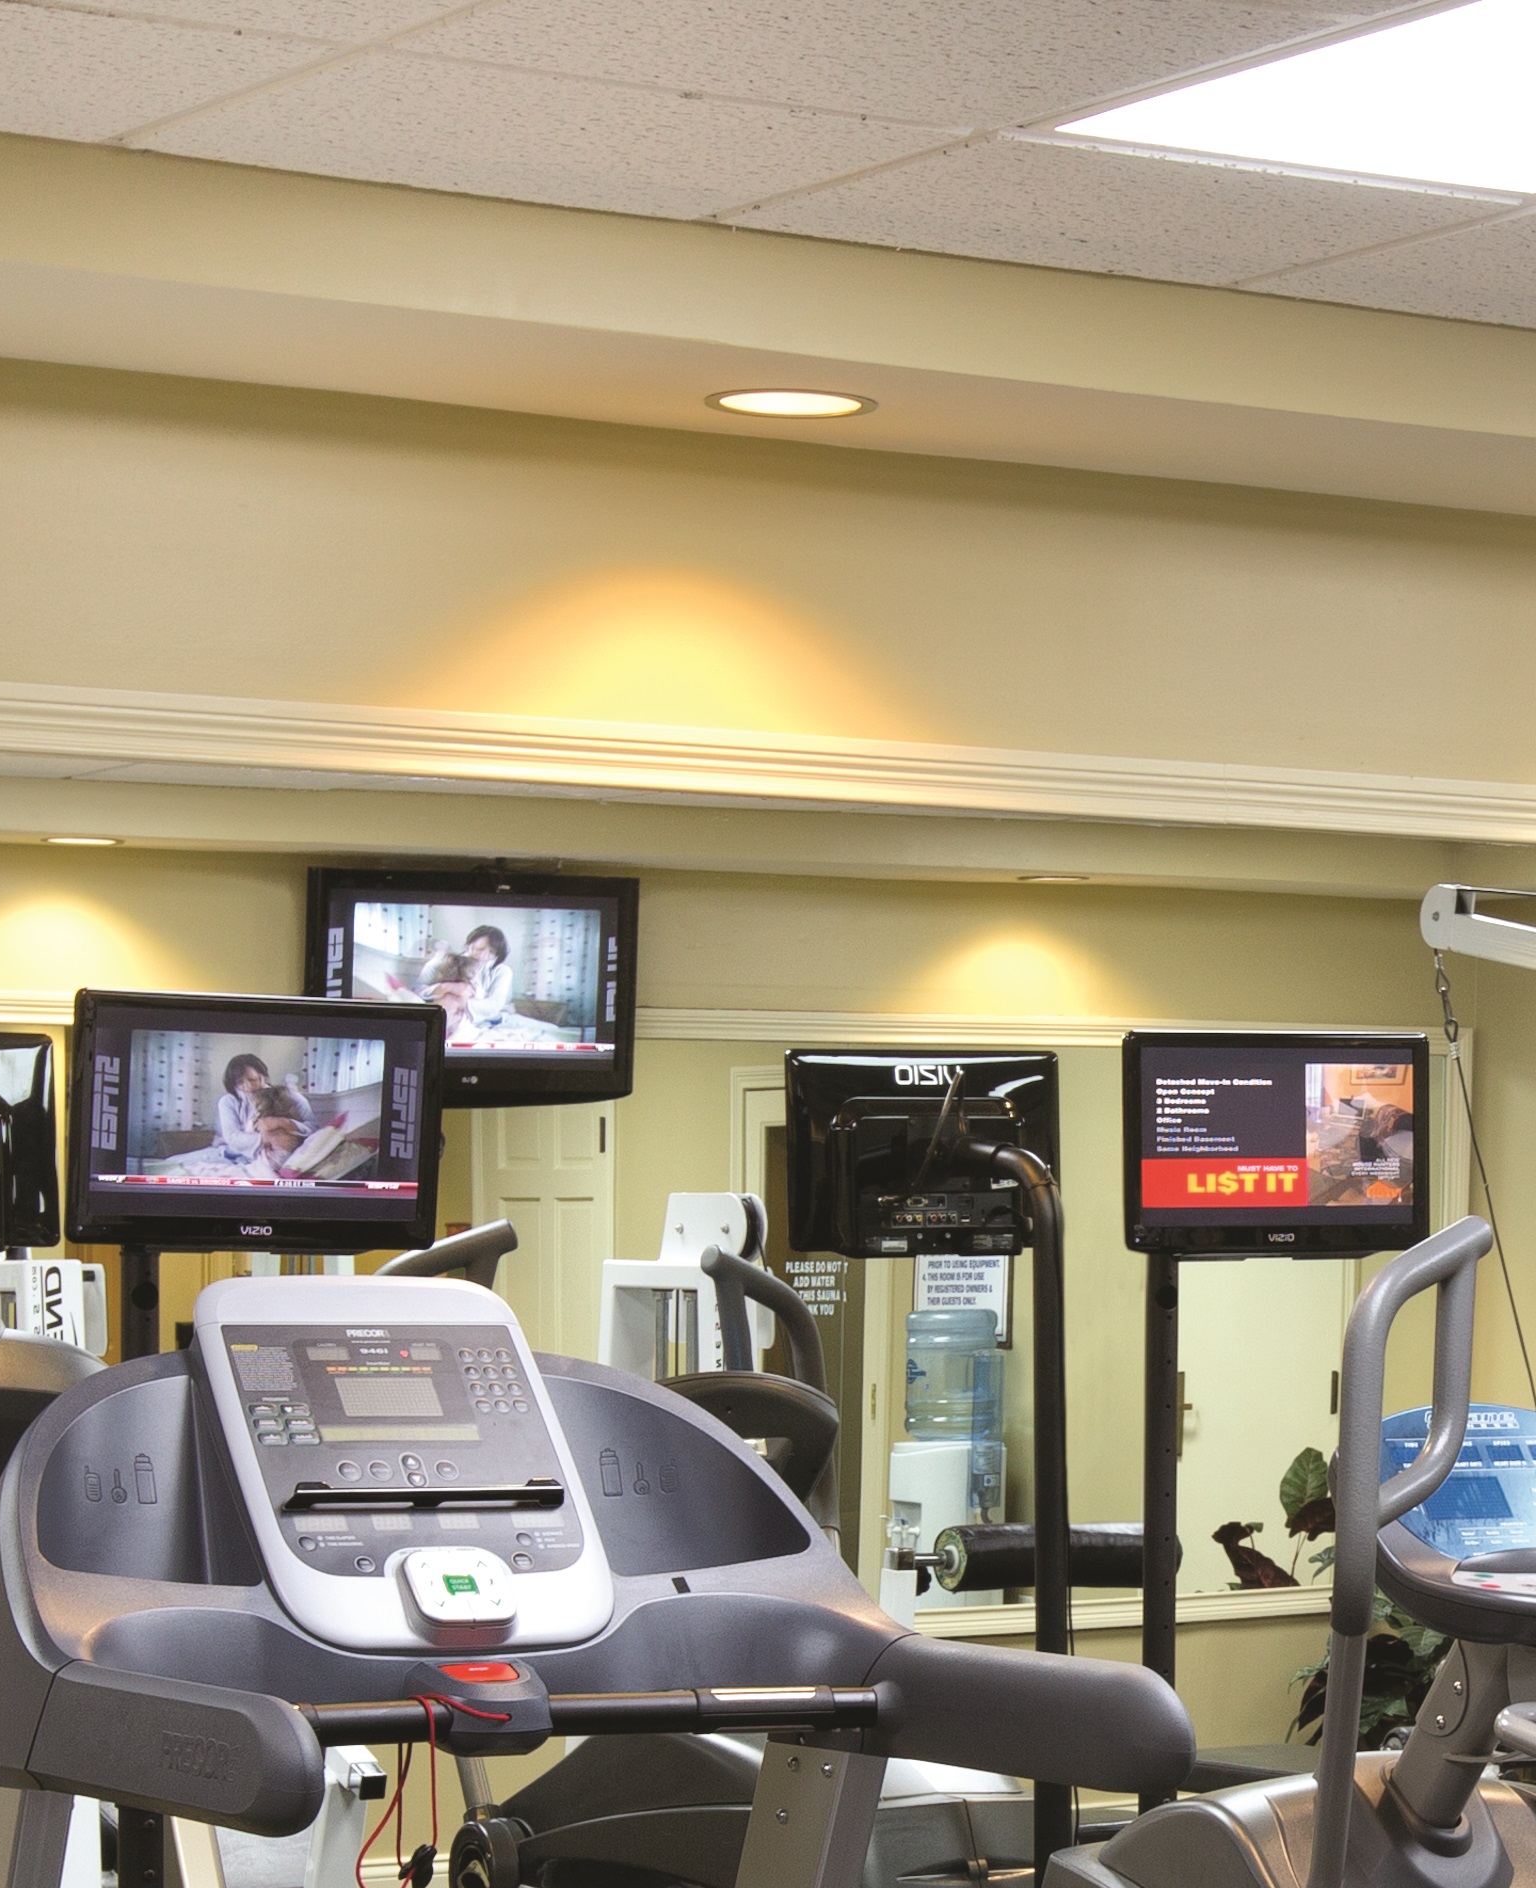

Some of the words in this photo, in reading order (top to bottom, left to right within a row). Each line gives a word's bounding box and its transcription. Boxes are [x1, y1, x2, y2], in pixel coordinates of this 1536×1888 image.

[1180, 1088, 1215, 1096] Concept
[92, 1055, 120, 1150] ESPN2
[390, 1067, 418, 1159] ESPN2
[1266, 1174, 1298, 1192] IT
[240, 1226, 272, 1235] VIZIO
[1268, 1233, 1294, 1242] VIZIO
[786, 1262, 814, 1273] PLEASE
[816, 1262, 826, 1273] DO
[827, 1262, 841, 1272] NOT
[928, 1261, 942, 1269] PRIOR
[793, 1276, 810, 1287] ADD
[811, 1276, 835, 1287] WATER
[928, 1273, 938, 1281] THIS
[939, 1273, 955, 1281] ROOM
[974, 1272, 984, 1280] USE
[817, 1290, 840, 1301] SAUNA
[942, 1297, 961, 1305] GUESTS
[820, 1304, 834, 1315] YOU
[346, 1329, 385, 1337] PRECOR
